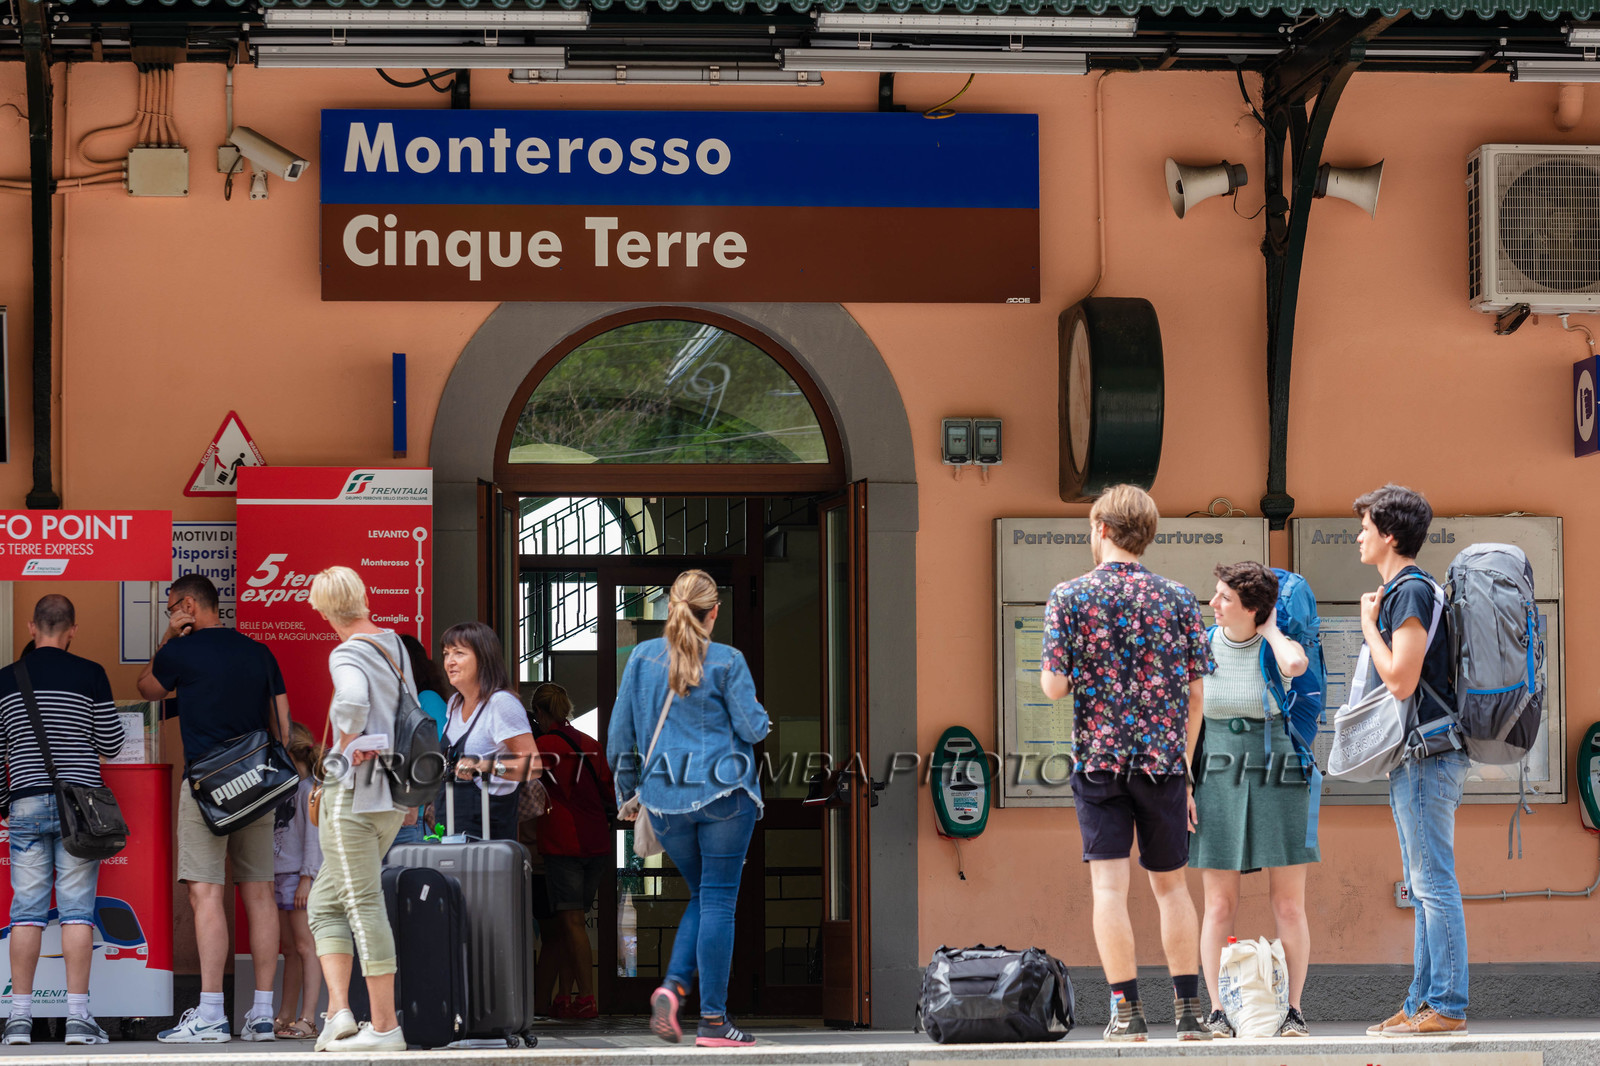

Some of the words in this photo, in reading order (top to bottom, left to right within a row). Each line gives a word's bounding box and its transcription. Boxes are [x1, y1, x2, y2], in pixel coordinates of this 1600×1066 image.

[343, 122, 731, 175] Monterosso
[343, 213, 562, 281] Cinque
[585, 216, 747, 268] Terre
[371, 487, 428, 495] TRENITALIA
[42, 514, 133, 540] POINT
[172, 531, 217, 542] MOTIVI
[221, 531, 233, 541] DI
[368, 530, 410, 538] LEVANTO
[1154, 531, 1224, 544] artures
[1311, 529, 1361, 544] Arriv
[7, 543, 42, 555] TERRE
[45, 543, 94, 555] EXPRESS
[361, 558, 410, 566] Monterosso
[246, 553, 288, 588] 5
[281, 570, 316, 587] ter
[370, 586, 410, 594] Vernazza
[240, 588, 310, 608] expre
[371, 614, 409, 624] Corniglia
[240, 622, 260, 630] BELLE
[262, 622, 274, 630] DA
[275, 622, 306, 630] VEDERE,
[264, 632, 276, 640] DA
[278, 632, 339, 640] RAGGIUNGERE
[210, 768, 262, 806] PUMA
